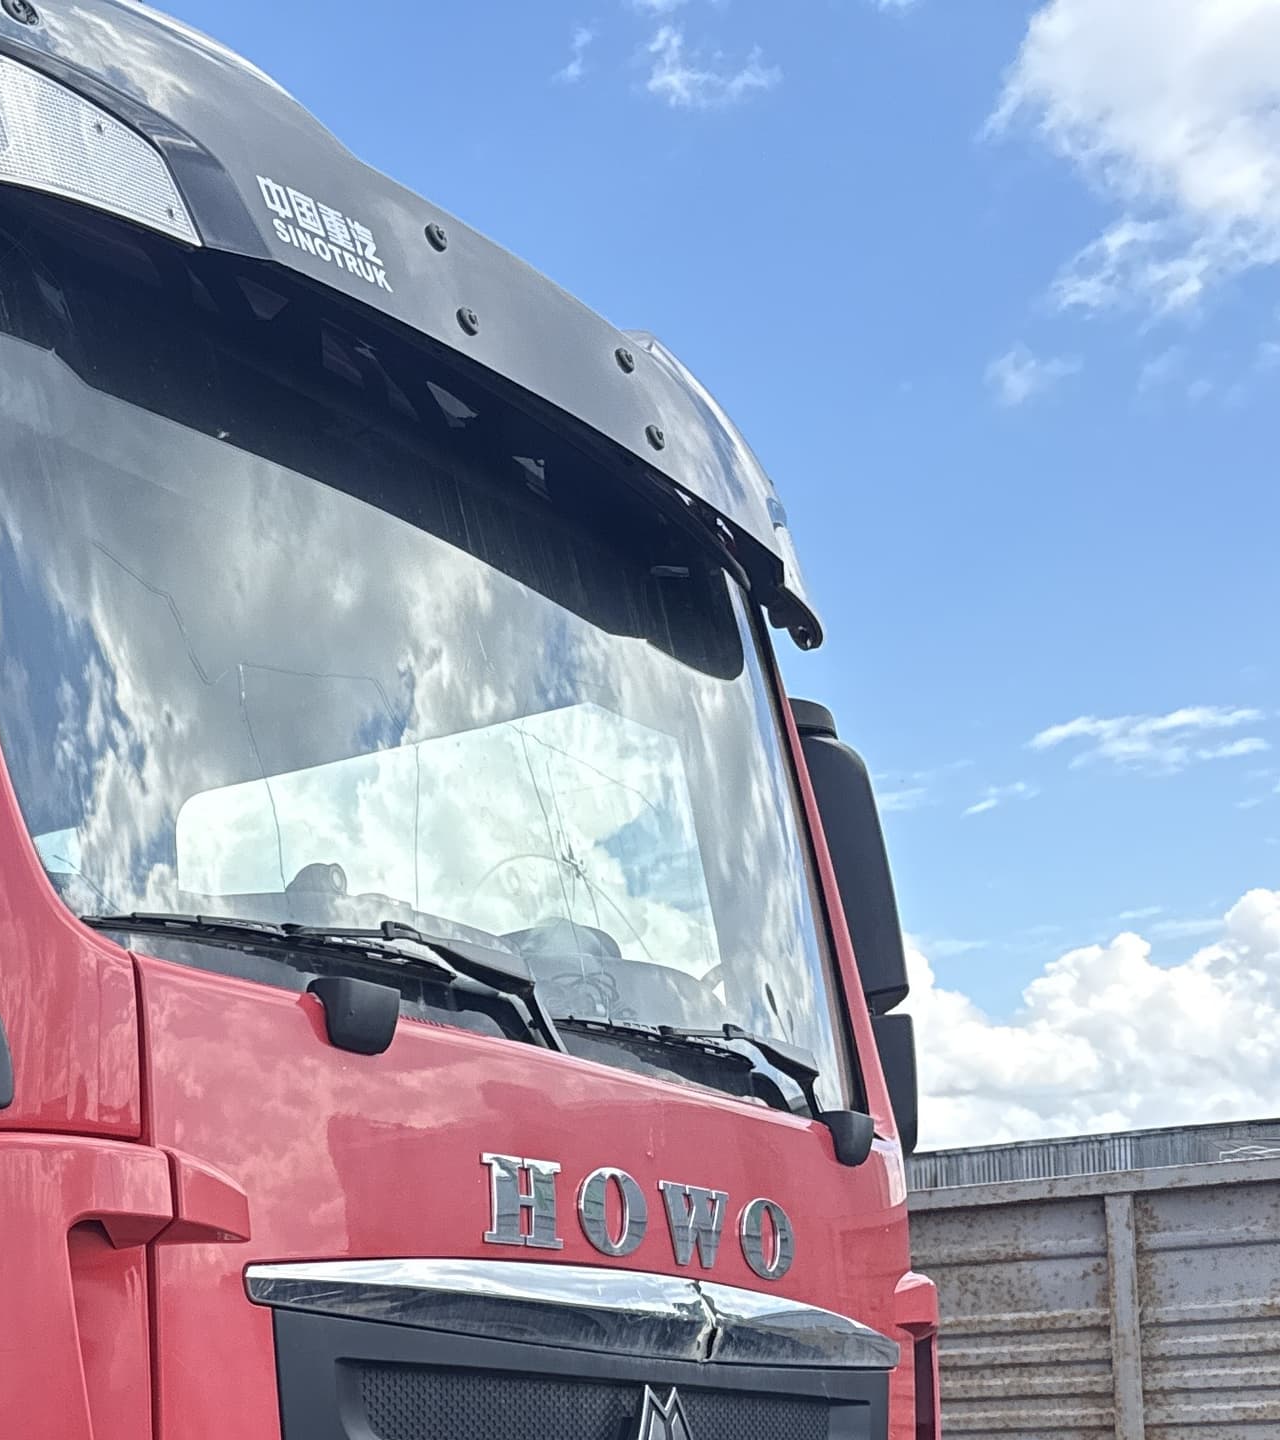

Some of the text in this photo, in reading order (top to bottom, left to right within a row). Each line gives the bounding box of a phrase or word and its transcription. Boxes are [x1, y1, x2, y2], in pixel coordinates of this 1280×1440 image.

[256, 175, 383, 267] 中国重汽
[272, 218, 393, 292] SINOTRUK
[480, 1152, 795, 1280] HOWO
